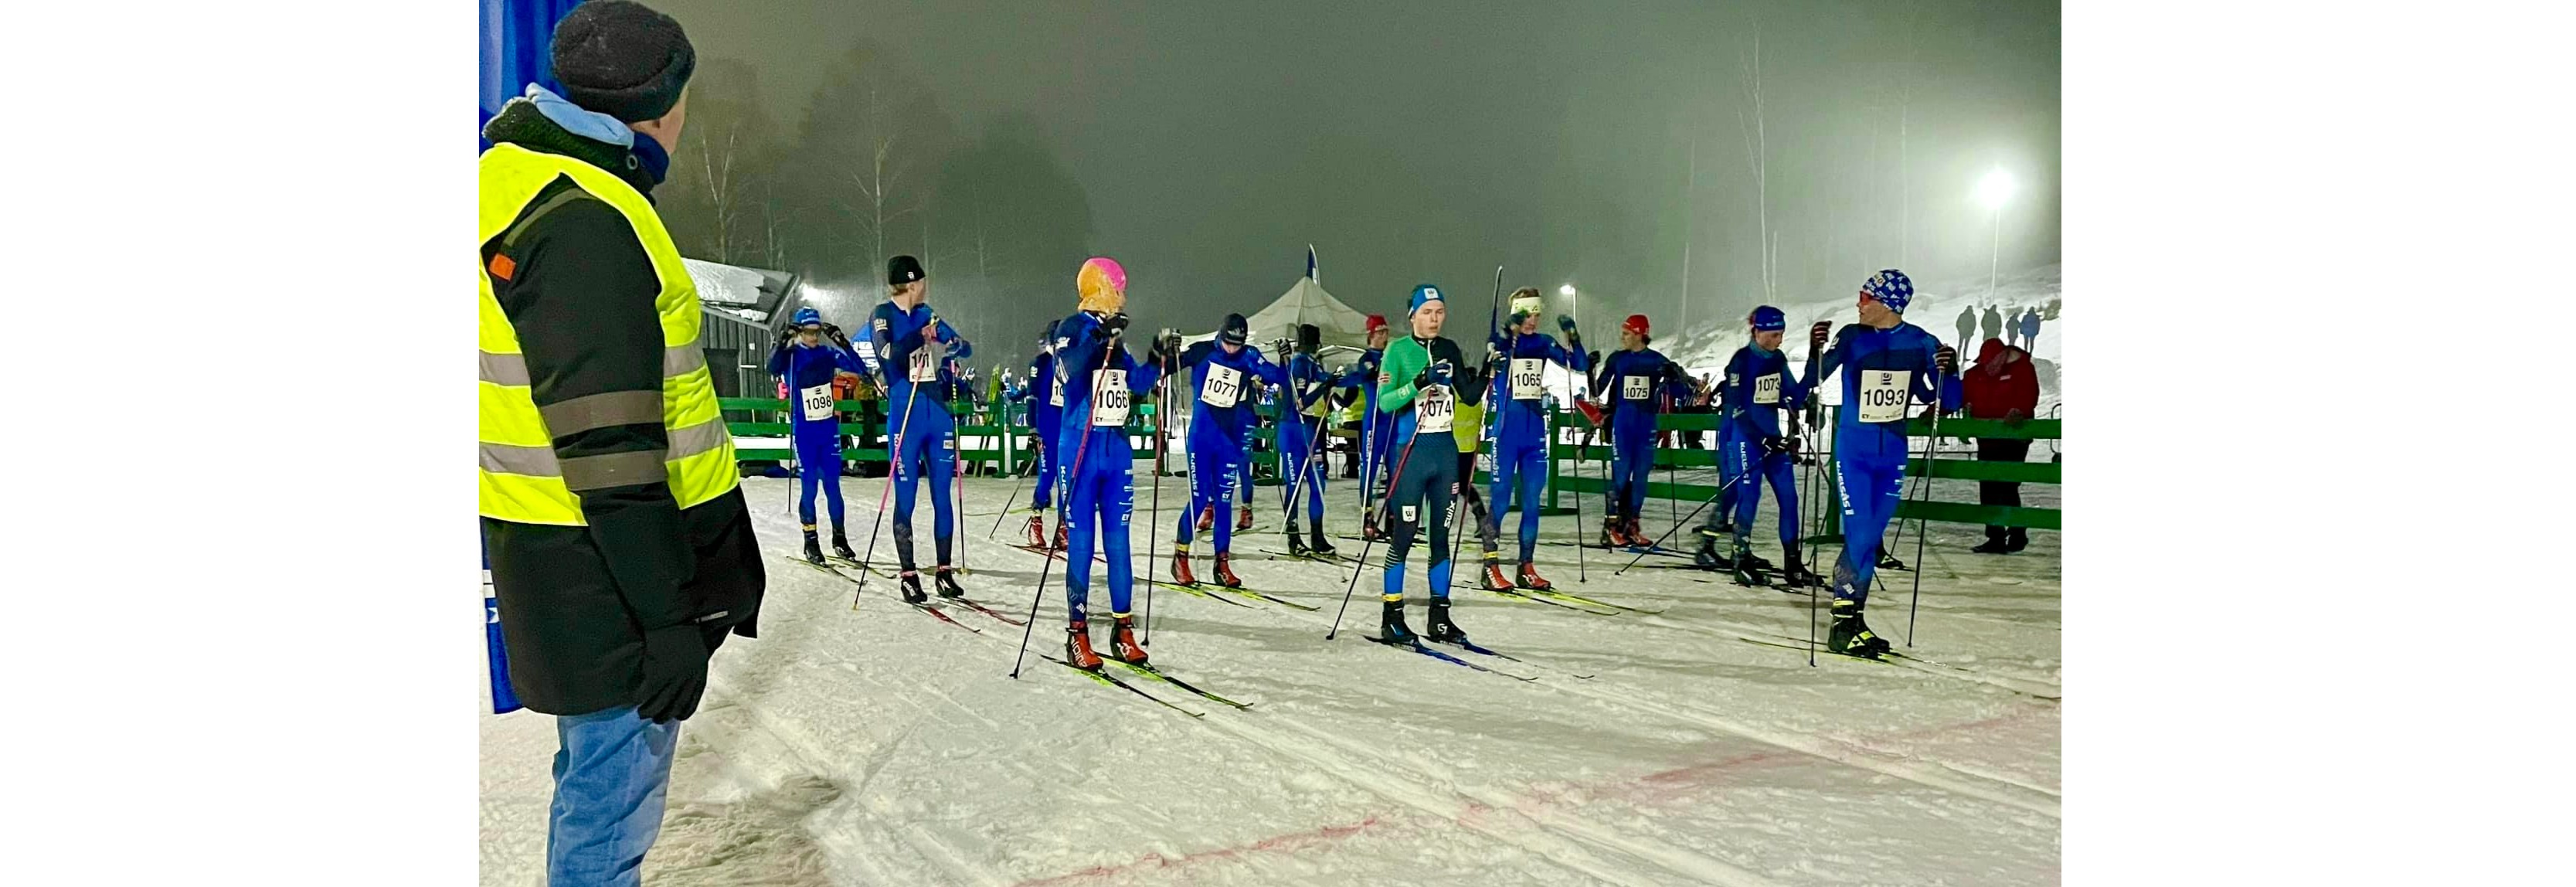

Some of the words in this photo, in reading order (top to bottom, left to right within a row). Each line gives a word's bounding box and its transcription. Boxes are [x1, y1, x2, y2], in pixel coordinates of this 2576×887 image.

[1514, 372, 1541, 386] 1065
[1208, 378, 1236, 397] 1077
[1625, 387, 1648, 397] 1075
[806, 395, 832, 410] 1098
[1098, 390, 1128, 408] 1066
[1864, 389, 1905, 406] 1093
